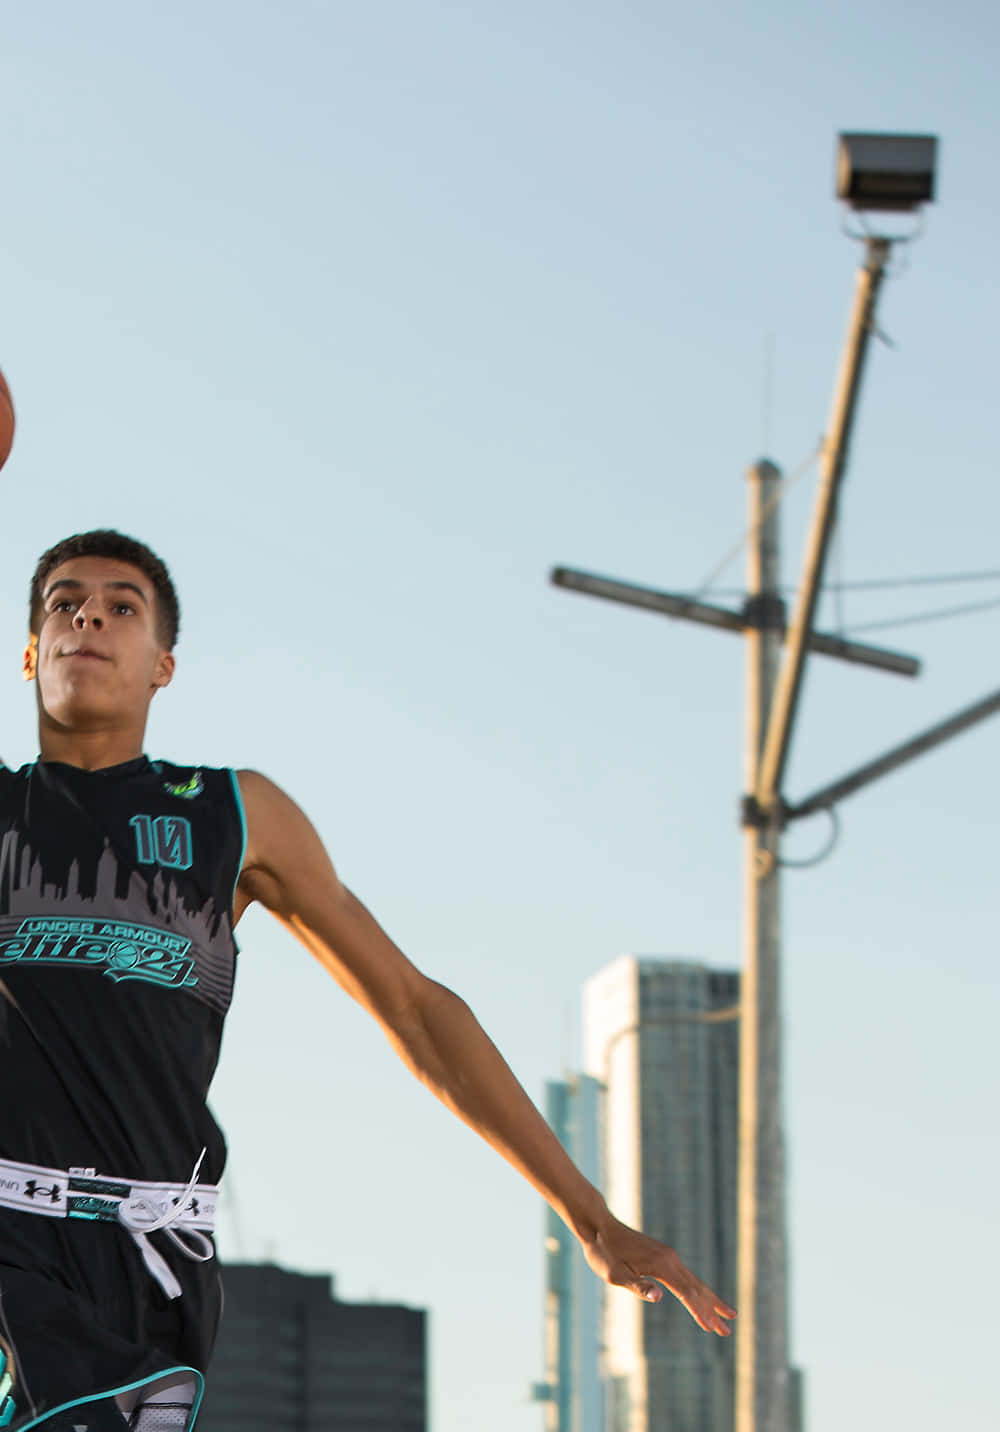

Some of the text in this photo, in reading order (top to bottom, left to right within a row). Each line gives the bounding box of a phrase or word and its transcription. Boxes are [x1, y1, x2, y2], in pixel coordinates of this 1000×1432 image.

[129, 814, 193, 870] 10
[27, 921, 182, 951] UNDER ARMOUR
